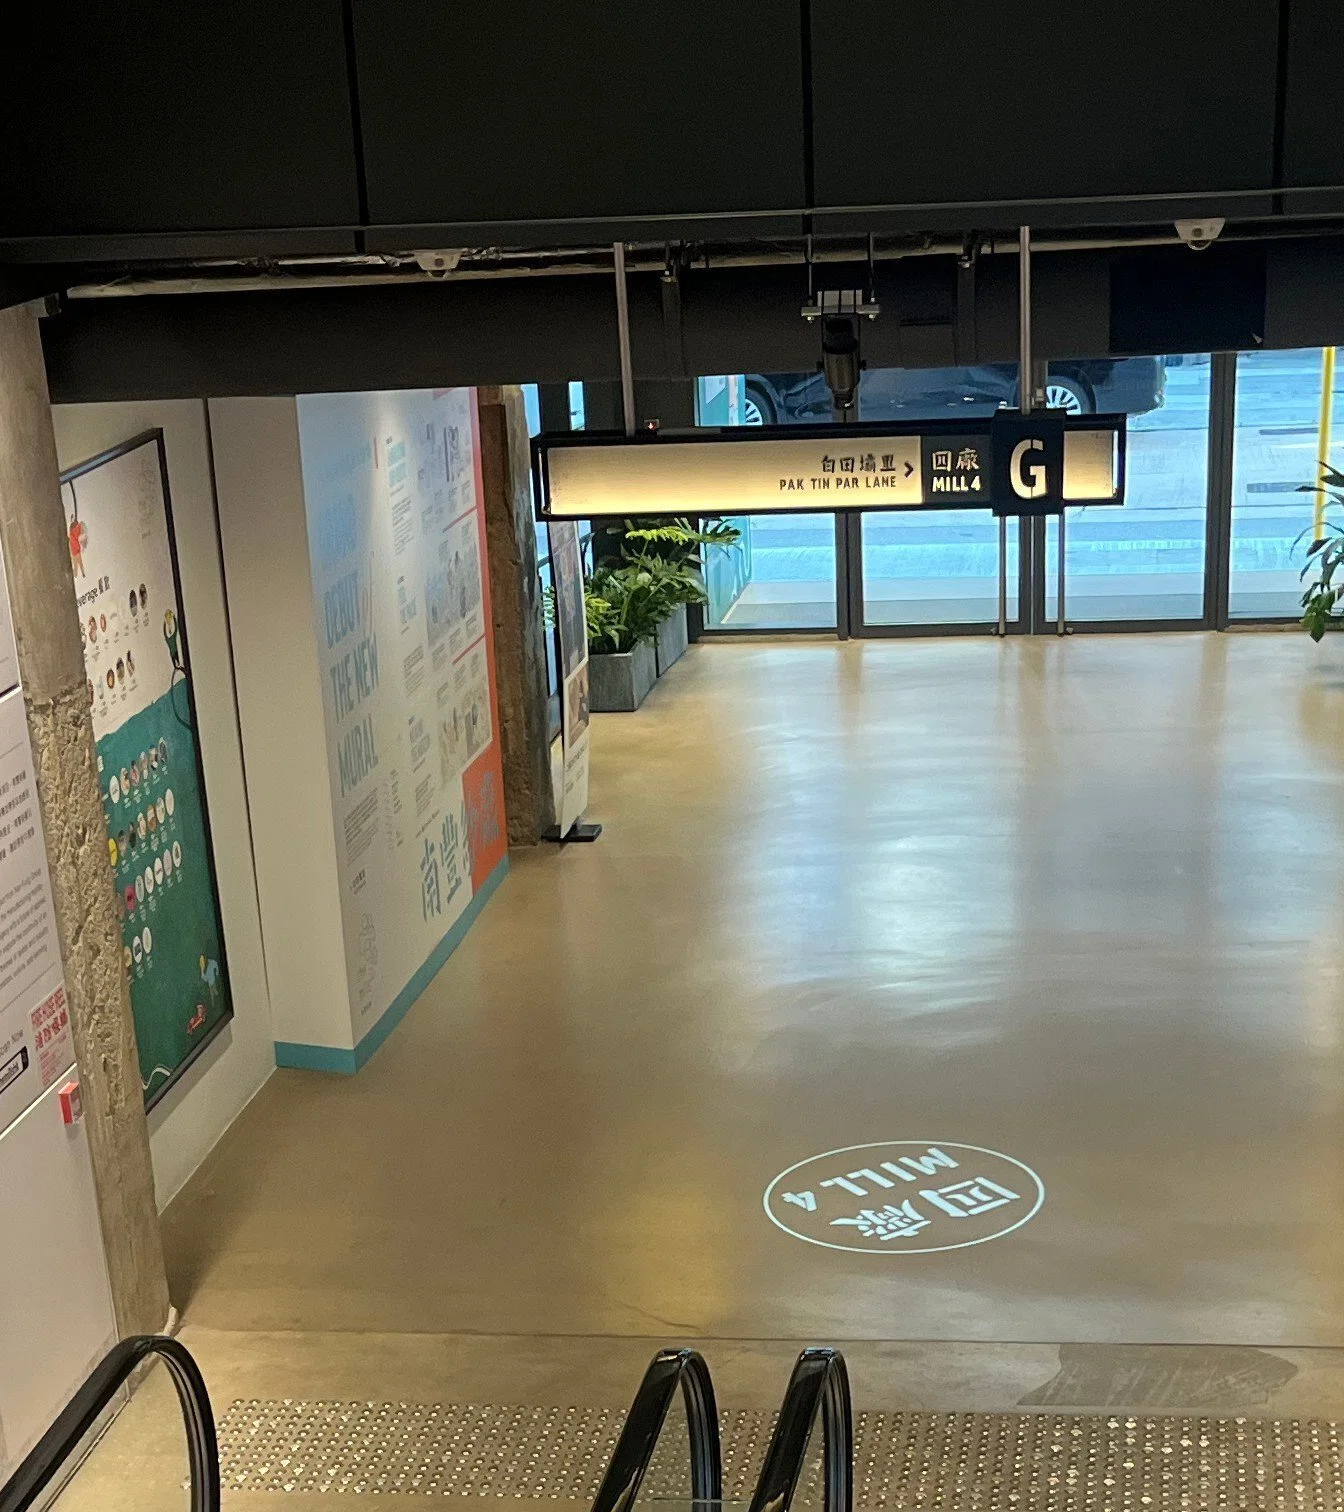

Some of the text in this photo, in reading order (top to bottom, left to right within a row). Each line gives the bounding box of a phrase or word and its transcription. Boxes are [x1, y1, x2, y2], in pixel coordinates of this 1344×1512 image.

[932, 448, 980, 472] 四廠
[1010, 439, 1047, 500] G
[779, 475, 896, 490] PAK TIN PAR LANE
[337, 713, 379, 798] MURAL
